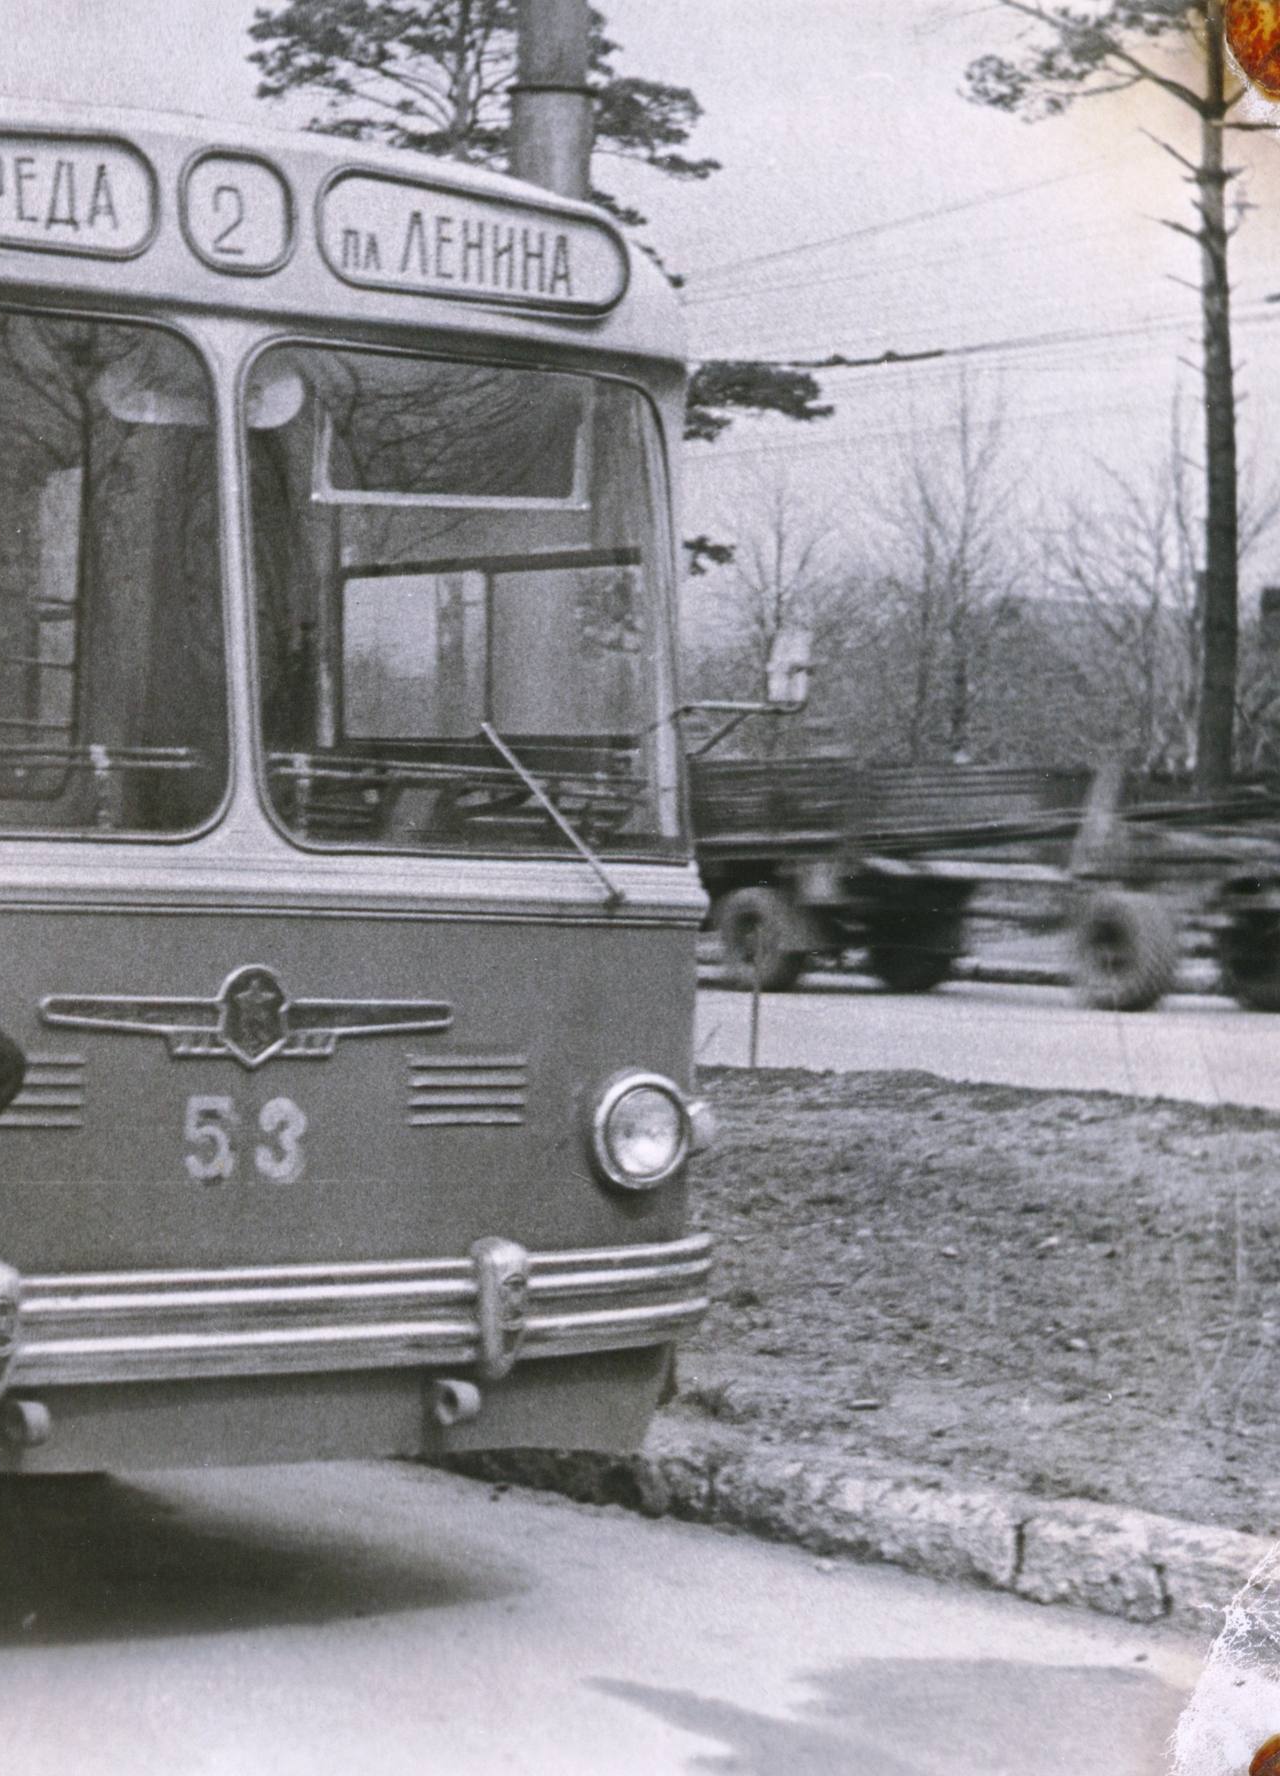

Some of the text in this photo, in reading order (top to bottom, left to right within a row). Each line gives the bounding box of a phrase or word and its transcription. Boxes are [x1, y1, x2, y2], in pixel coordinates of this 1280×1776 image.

[213, 184, 246, 255] 2
[399, 210, 573, 296] ЛЕНИНА
[184, 1096, 308, 1184] 53
